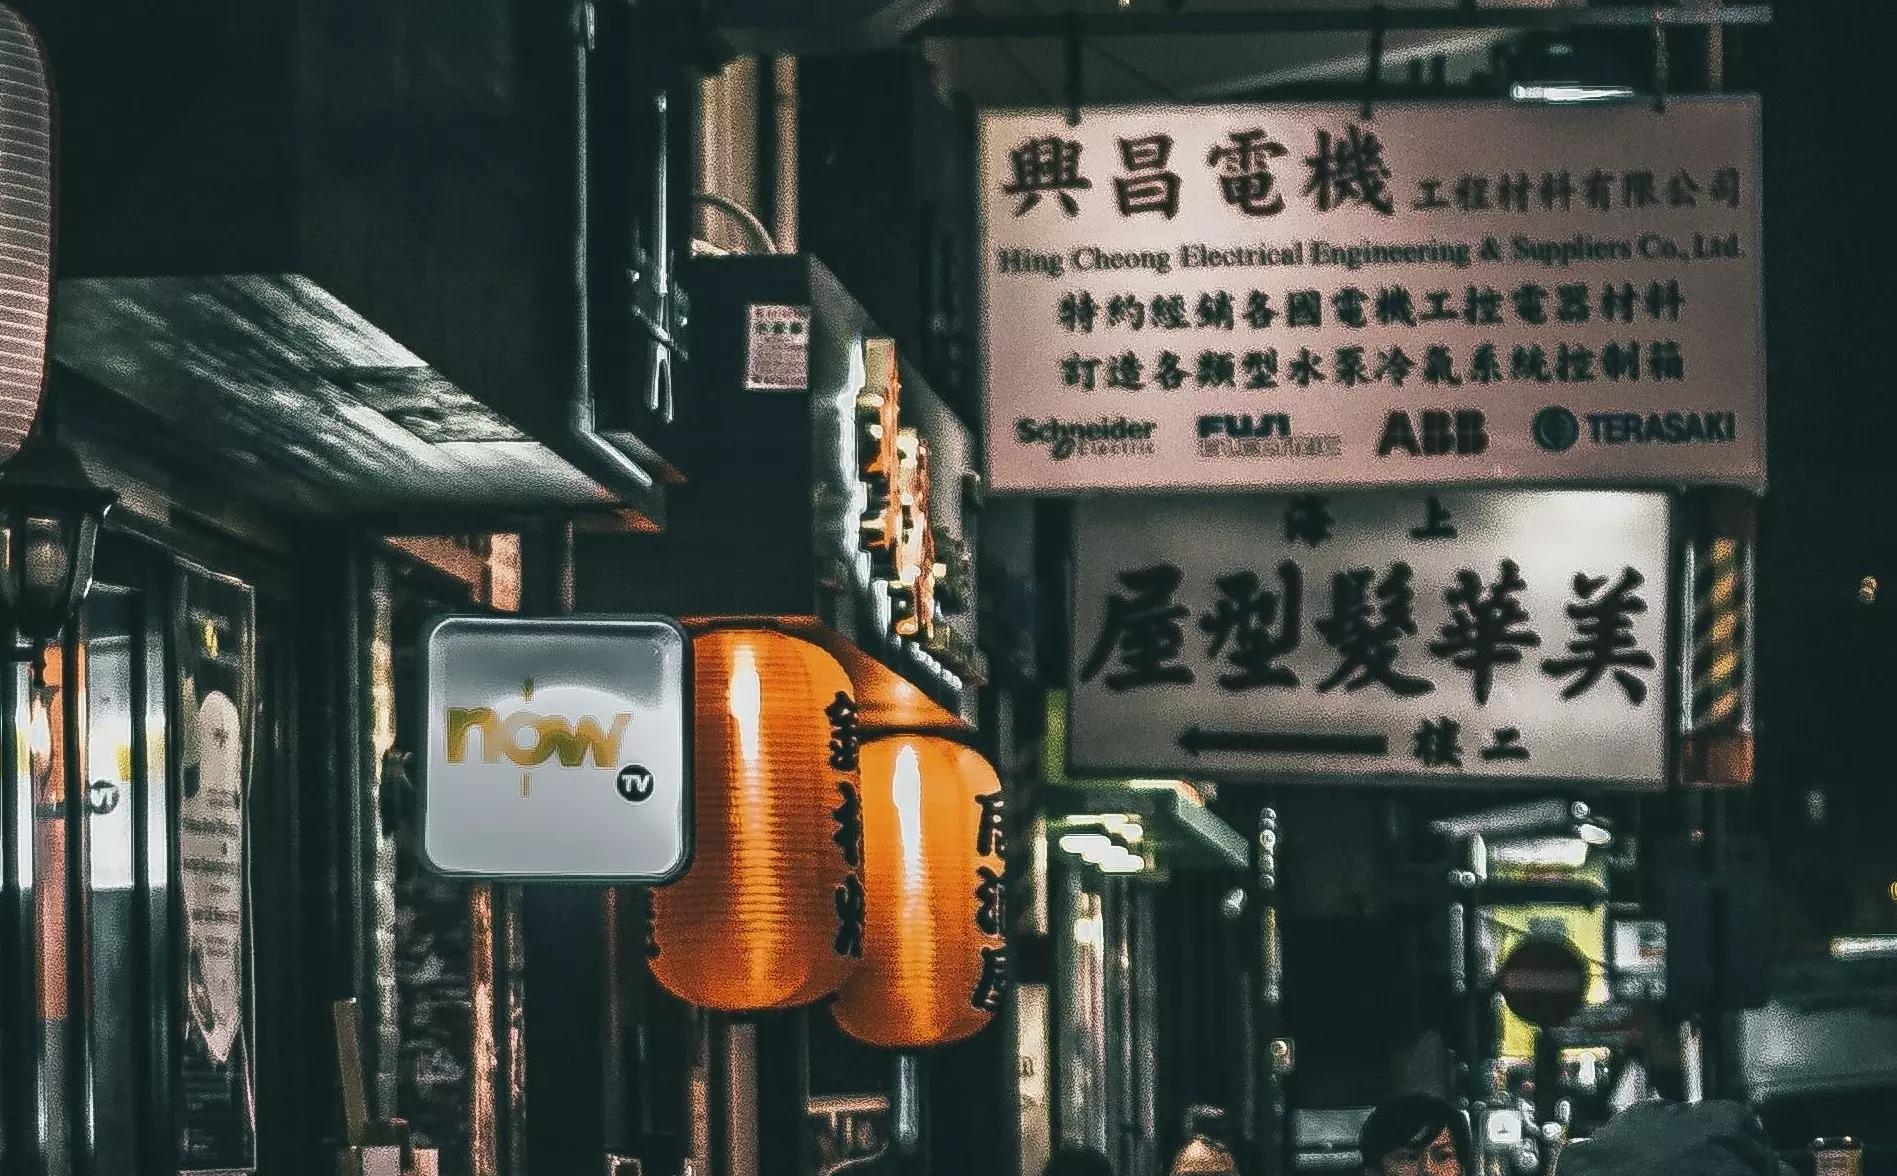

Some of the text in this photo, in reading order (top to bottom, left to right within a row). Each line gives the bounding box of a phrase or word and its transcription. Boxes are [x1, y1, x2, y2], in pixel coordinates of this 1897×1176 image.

[1002, 124, 1741, 219] 興昌電機 工程材料有限公司
[999, 247, 1064, 277] Hing
[1071, 245, 1171, 273] Cheong
[1180, 241, 1304, 268] Electrical
[1309, 239, 1471, 269] Engineering
[1478, 235, 1503, 261] &
[1015, 416, 1157, 444] Schneider
[1196, 412, 1291, 438] FUJI
[1377, 408, 1490, 456] ABB
[1587, 411, 1736, 443] TERASAKI
[1078, 557, 1657, 706] 美華髮型屋
[445, 706, 634, 770] now
[621, 773, 652, 793] TV
